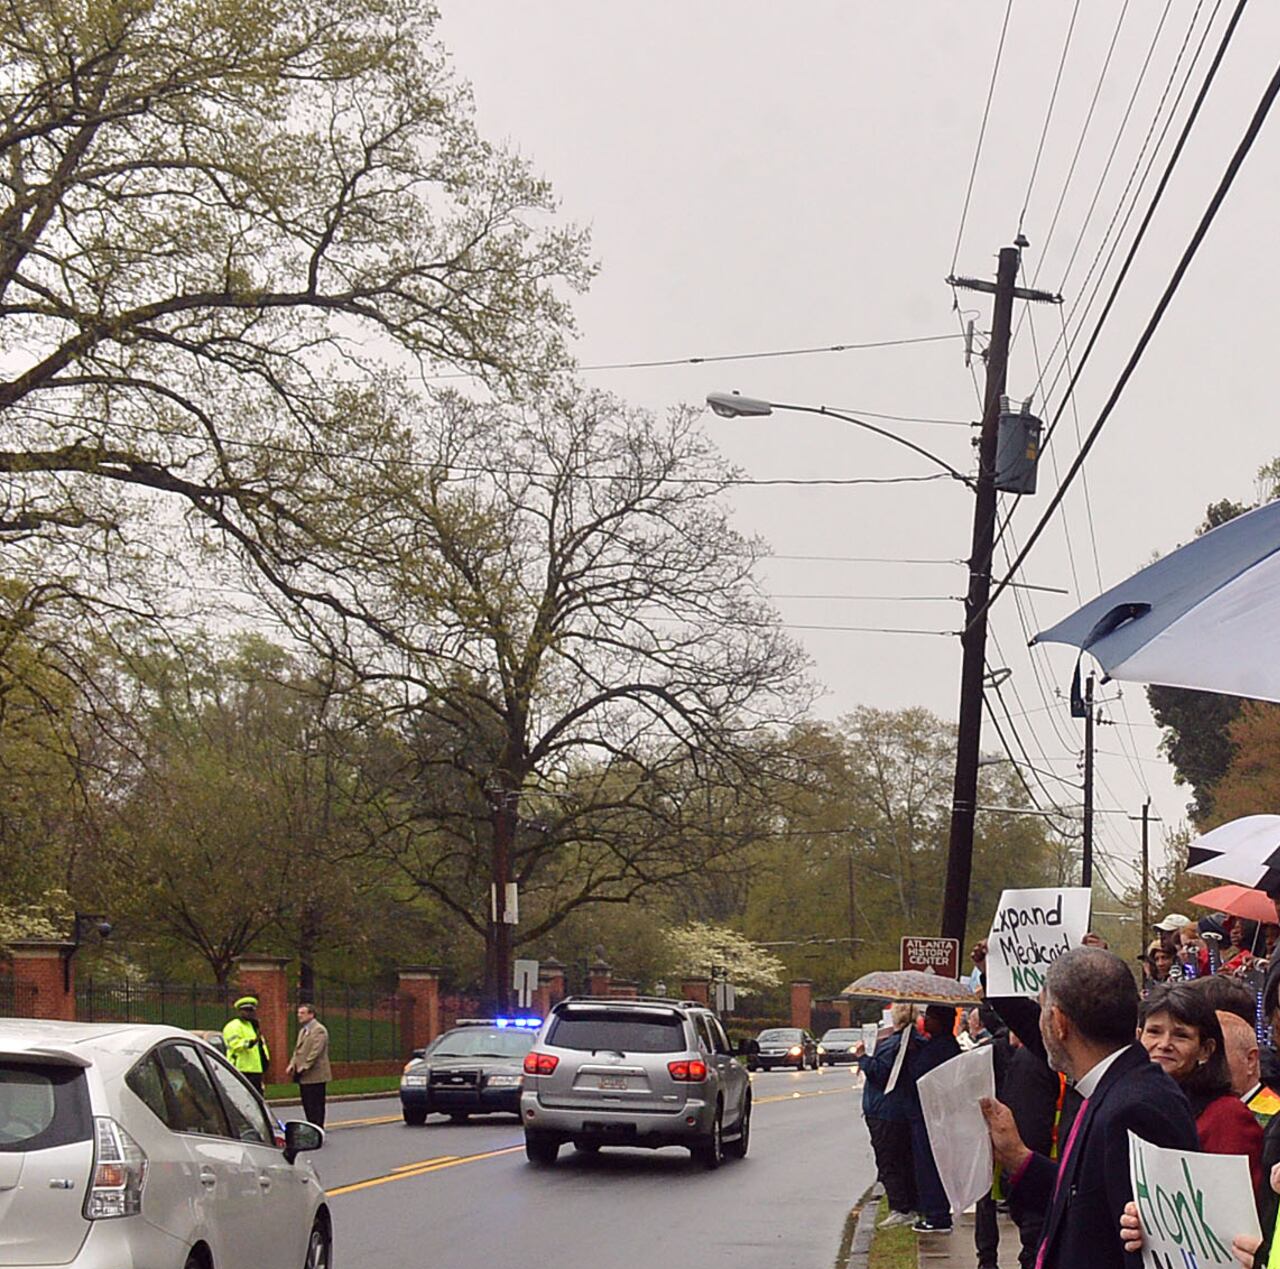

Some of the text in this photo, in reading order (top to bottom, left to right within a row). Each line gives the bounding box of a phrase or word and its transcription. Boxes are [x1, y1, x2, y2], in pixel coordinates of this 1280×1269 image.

[993, 895, 1062, 944] xpand
[906, 940, 953, 950] ATLANTA
[908, 948, 951, 957] HISTORY
[909, 956, 950, 965] CENTER
[1132, 1138, 1233, 1264] Honk
